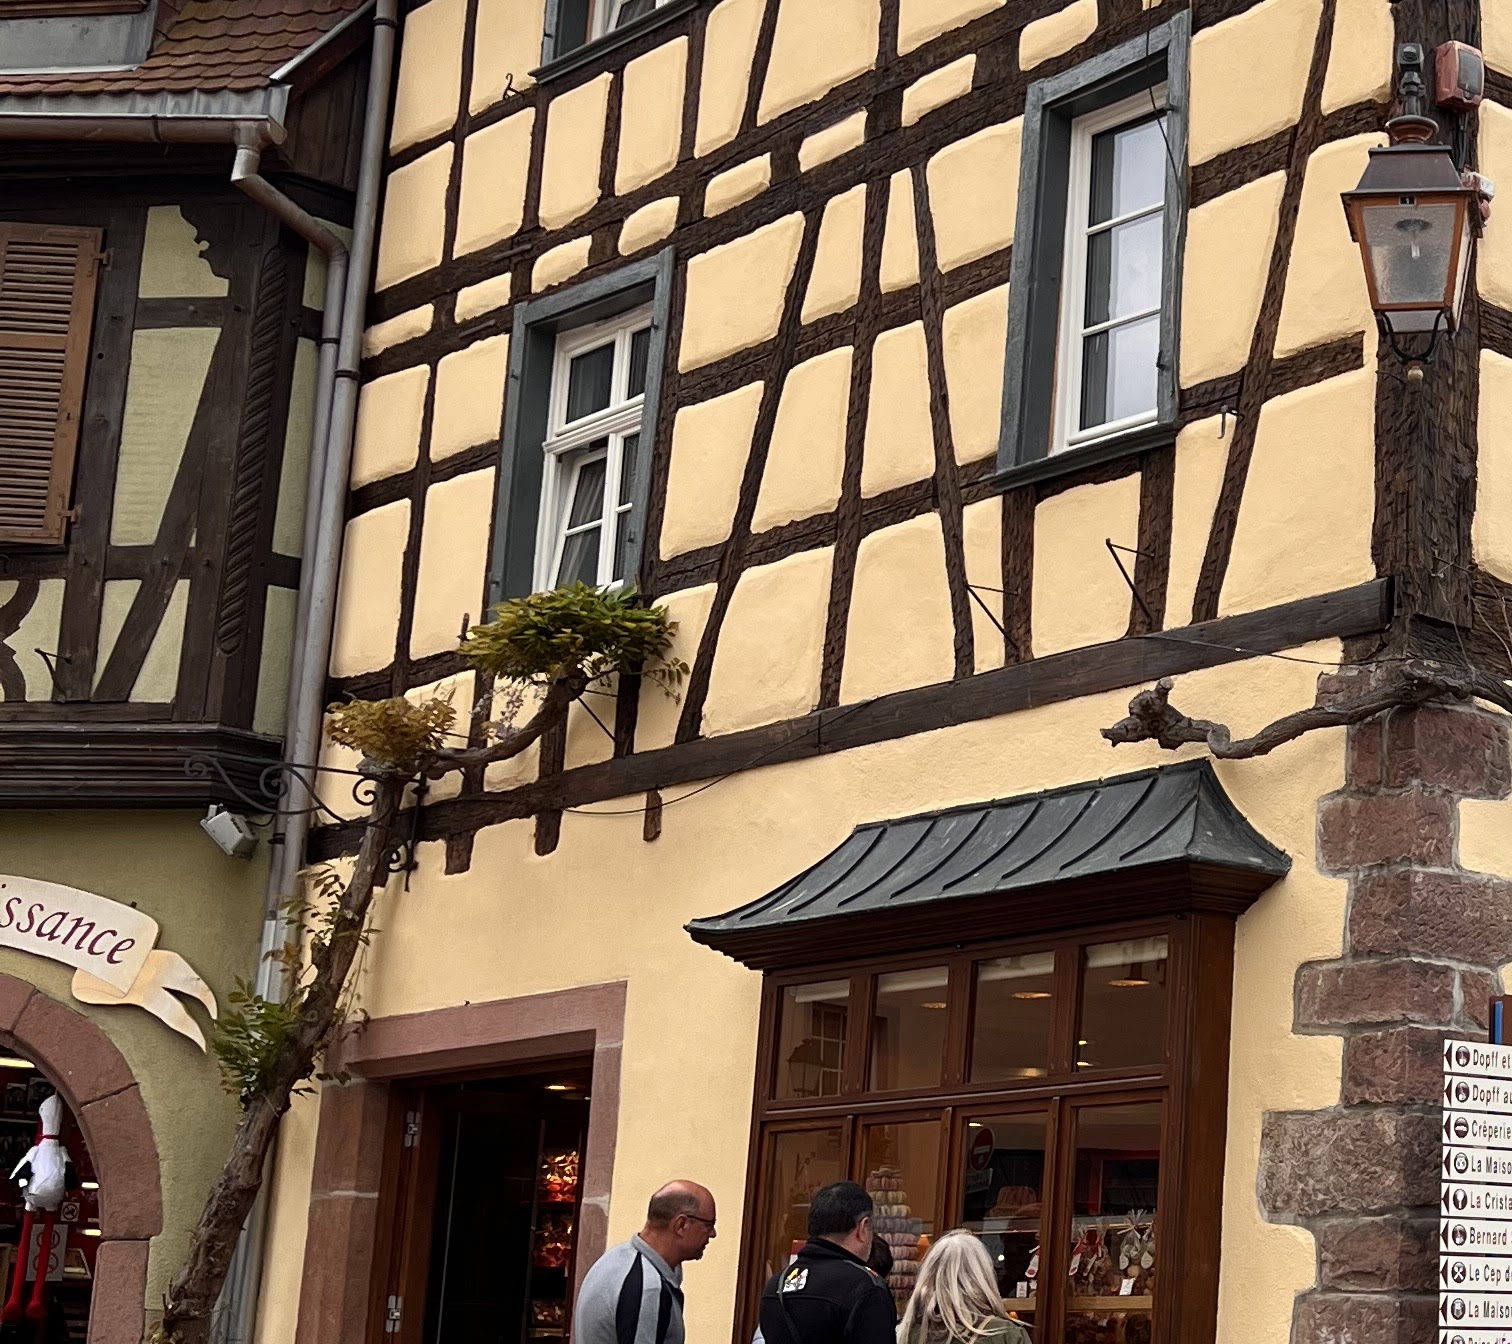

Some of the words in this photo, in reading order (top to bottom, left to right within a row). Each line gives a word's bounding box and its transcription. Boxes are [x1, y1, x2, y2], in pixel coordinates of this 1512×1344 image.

[0, 884, 136, 965] ssance
[1473, 1049, 1498, 1070] Dopff
[1502, 1054, 1510, 1066] et
[1473, 1084, 1500, 1106] Dopff
[1471, 1155, 1481, 1172] La
[1471, 1191, 1481, 1208] La
[1470, 1227, 1507, 1245] Bernard
[1469, 1264, 1480, 1281] Le
[1484, 1264, 1501, 1286] Cep
[1468, 1300, 1479, 1318] La
